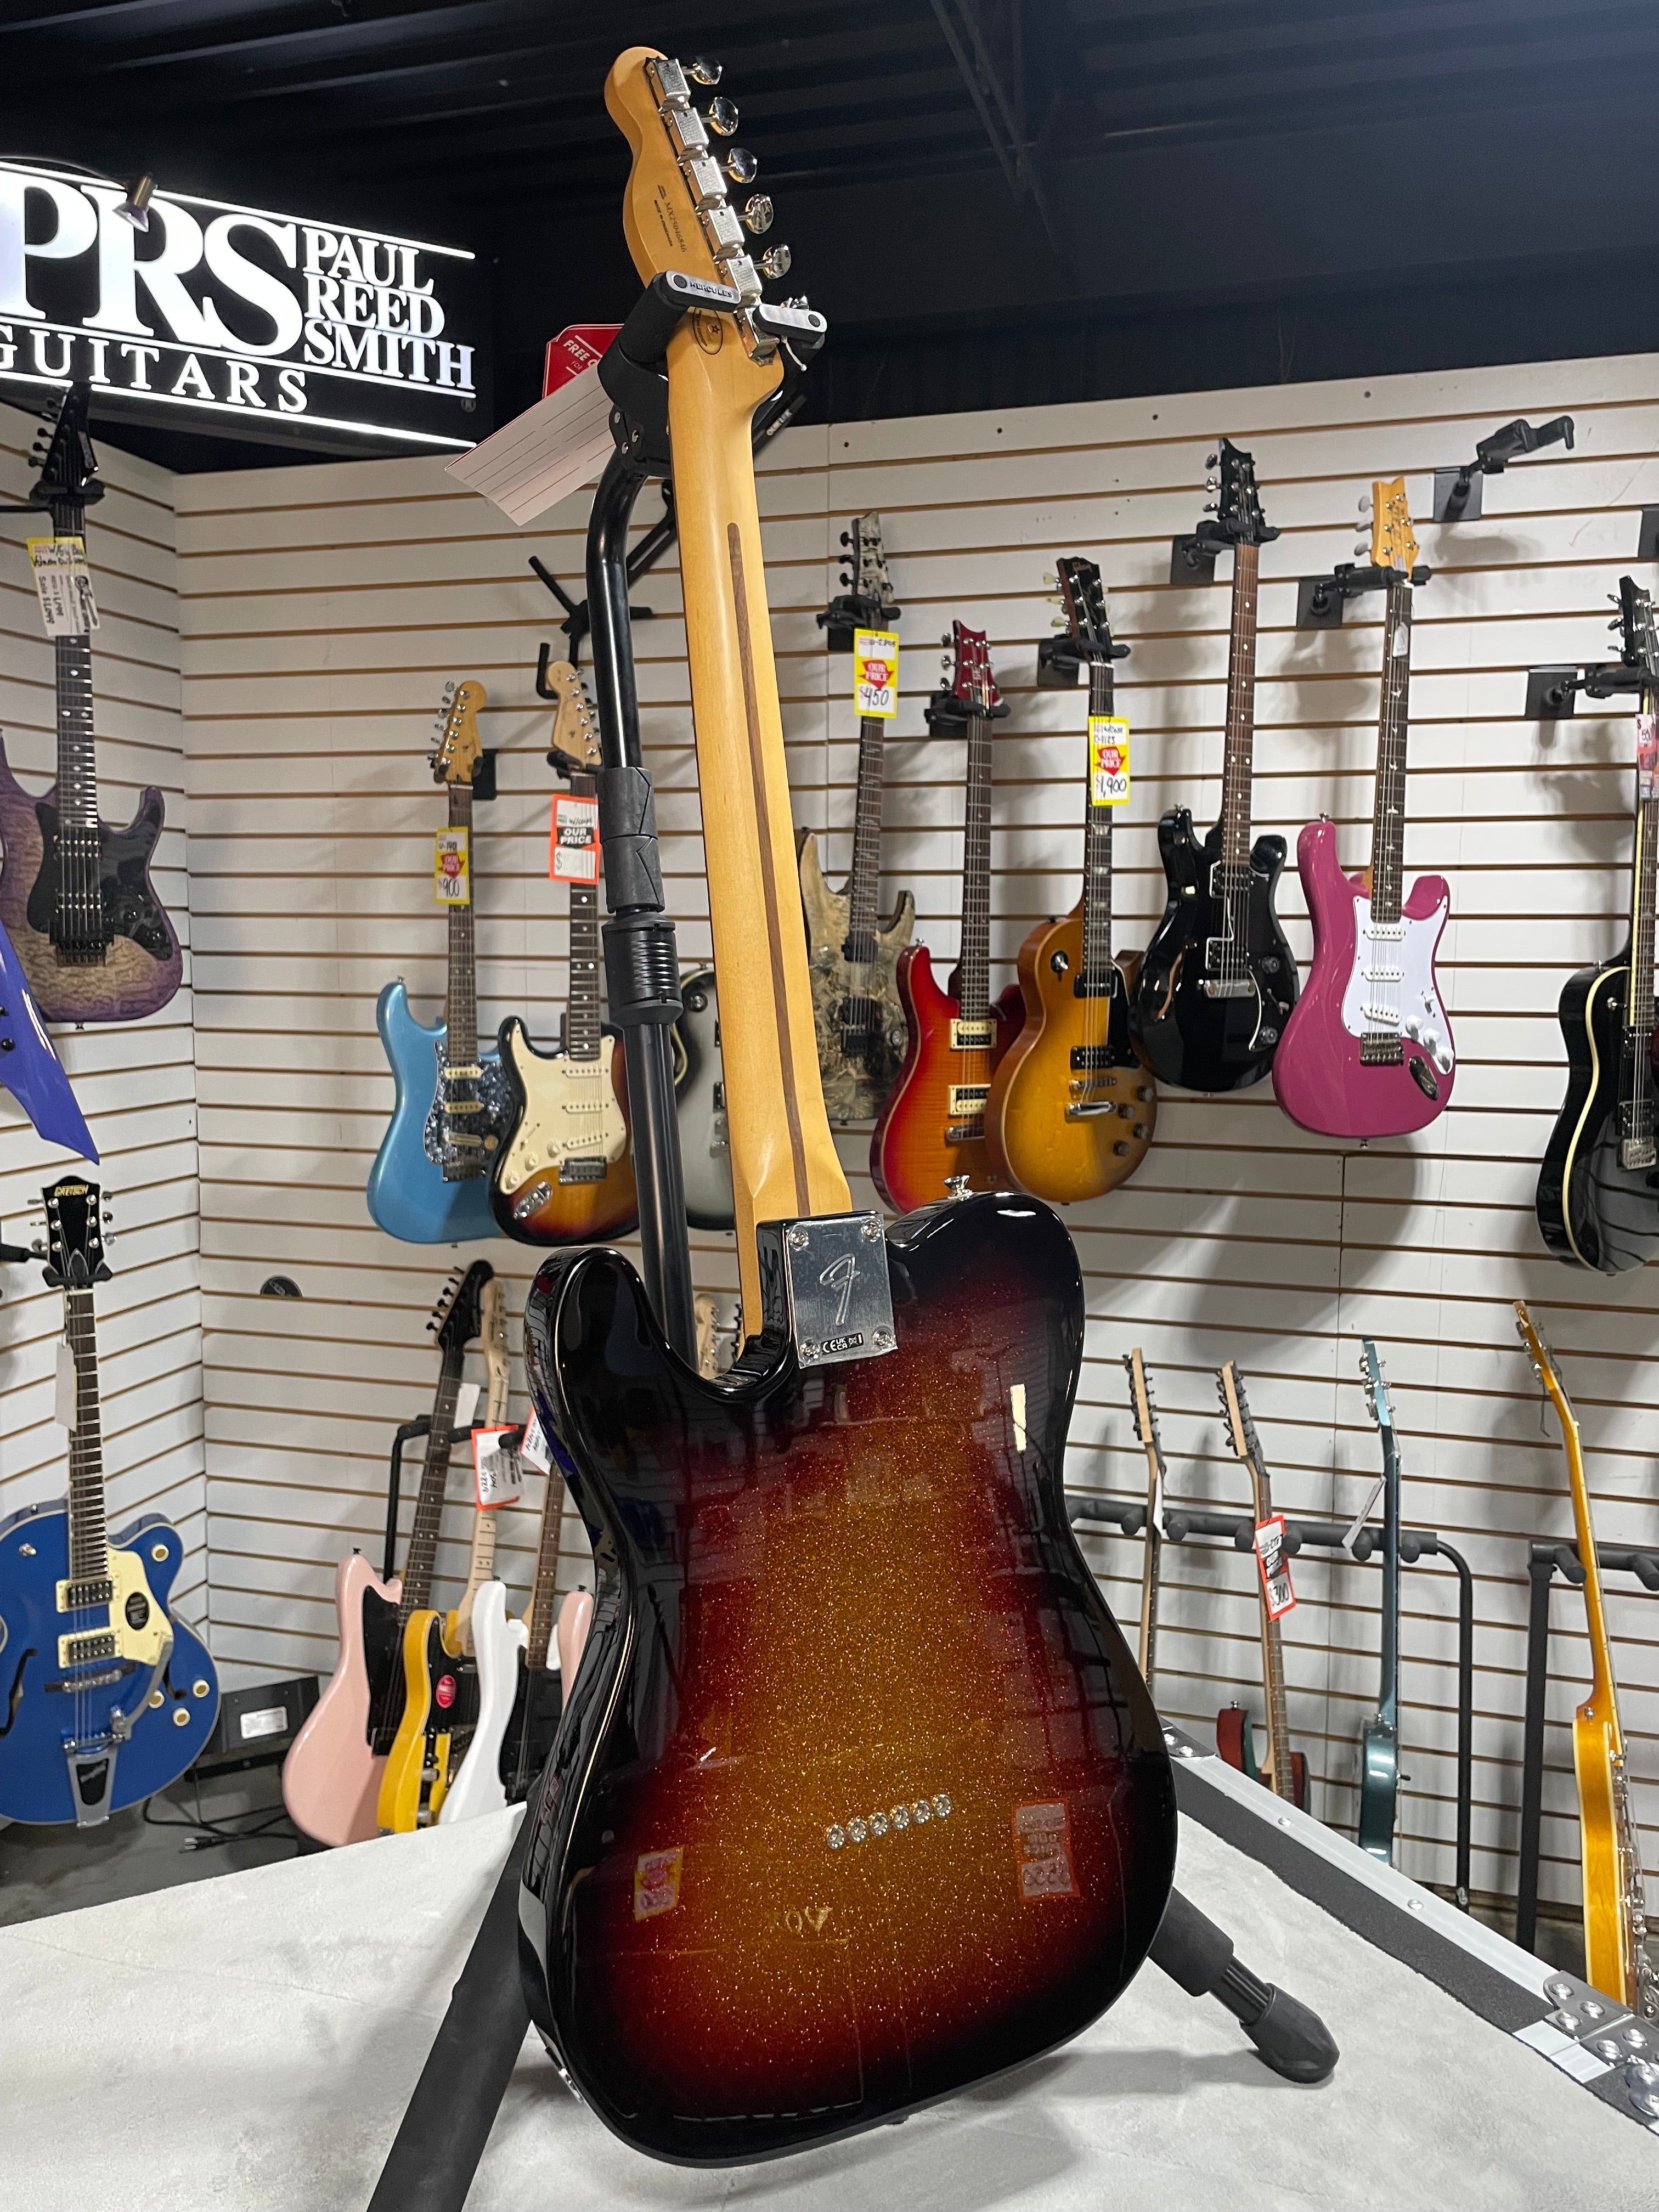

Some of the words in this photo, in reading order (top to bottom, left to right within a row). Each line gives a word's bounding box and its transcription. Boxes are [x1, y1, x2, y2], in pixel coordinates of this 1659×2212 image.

[0, 167, 303, 357] PRS
[302, 226, 435, 296] PAUL
[689, 280, 733, 298] HERCULES
[303, 272, 445, 339] REED
[303, 318, 476, 391] SMITH
[563, 340, 590, 361] FREE
[867, 662, 887, 673] OUR
[865, 671, 889, 681] PRICE
[1102, 748, 1119, 760] OUR
[1101, 758, 1121, 769] PRICE
[564, 827, 587, 836] OUR
[560, 835, 592, 845] PRICE
[556, 851, 562, 871] $
[837, 1342, 848, 1351] CA
